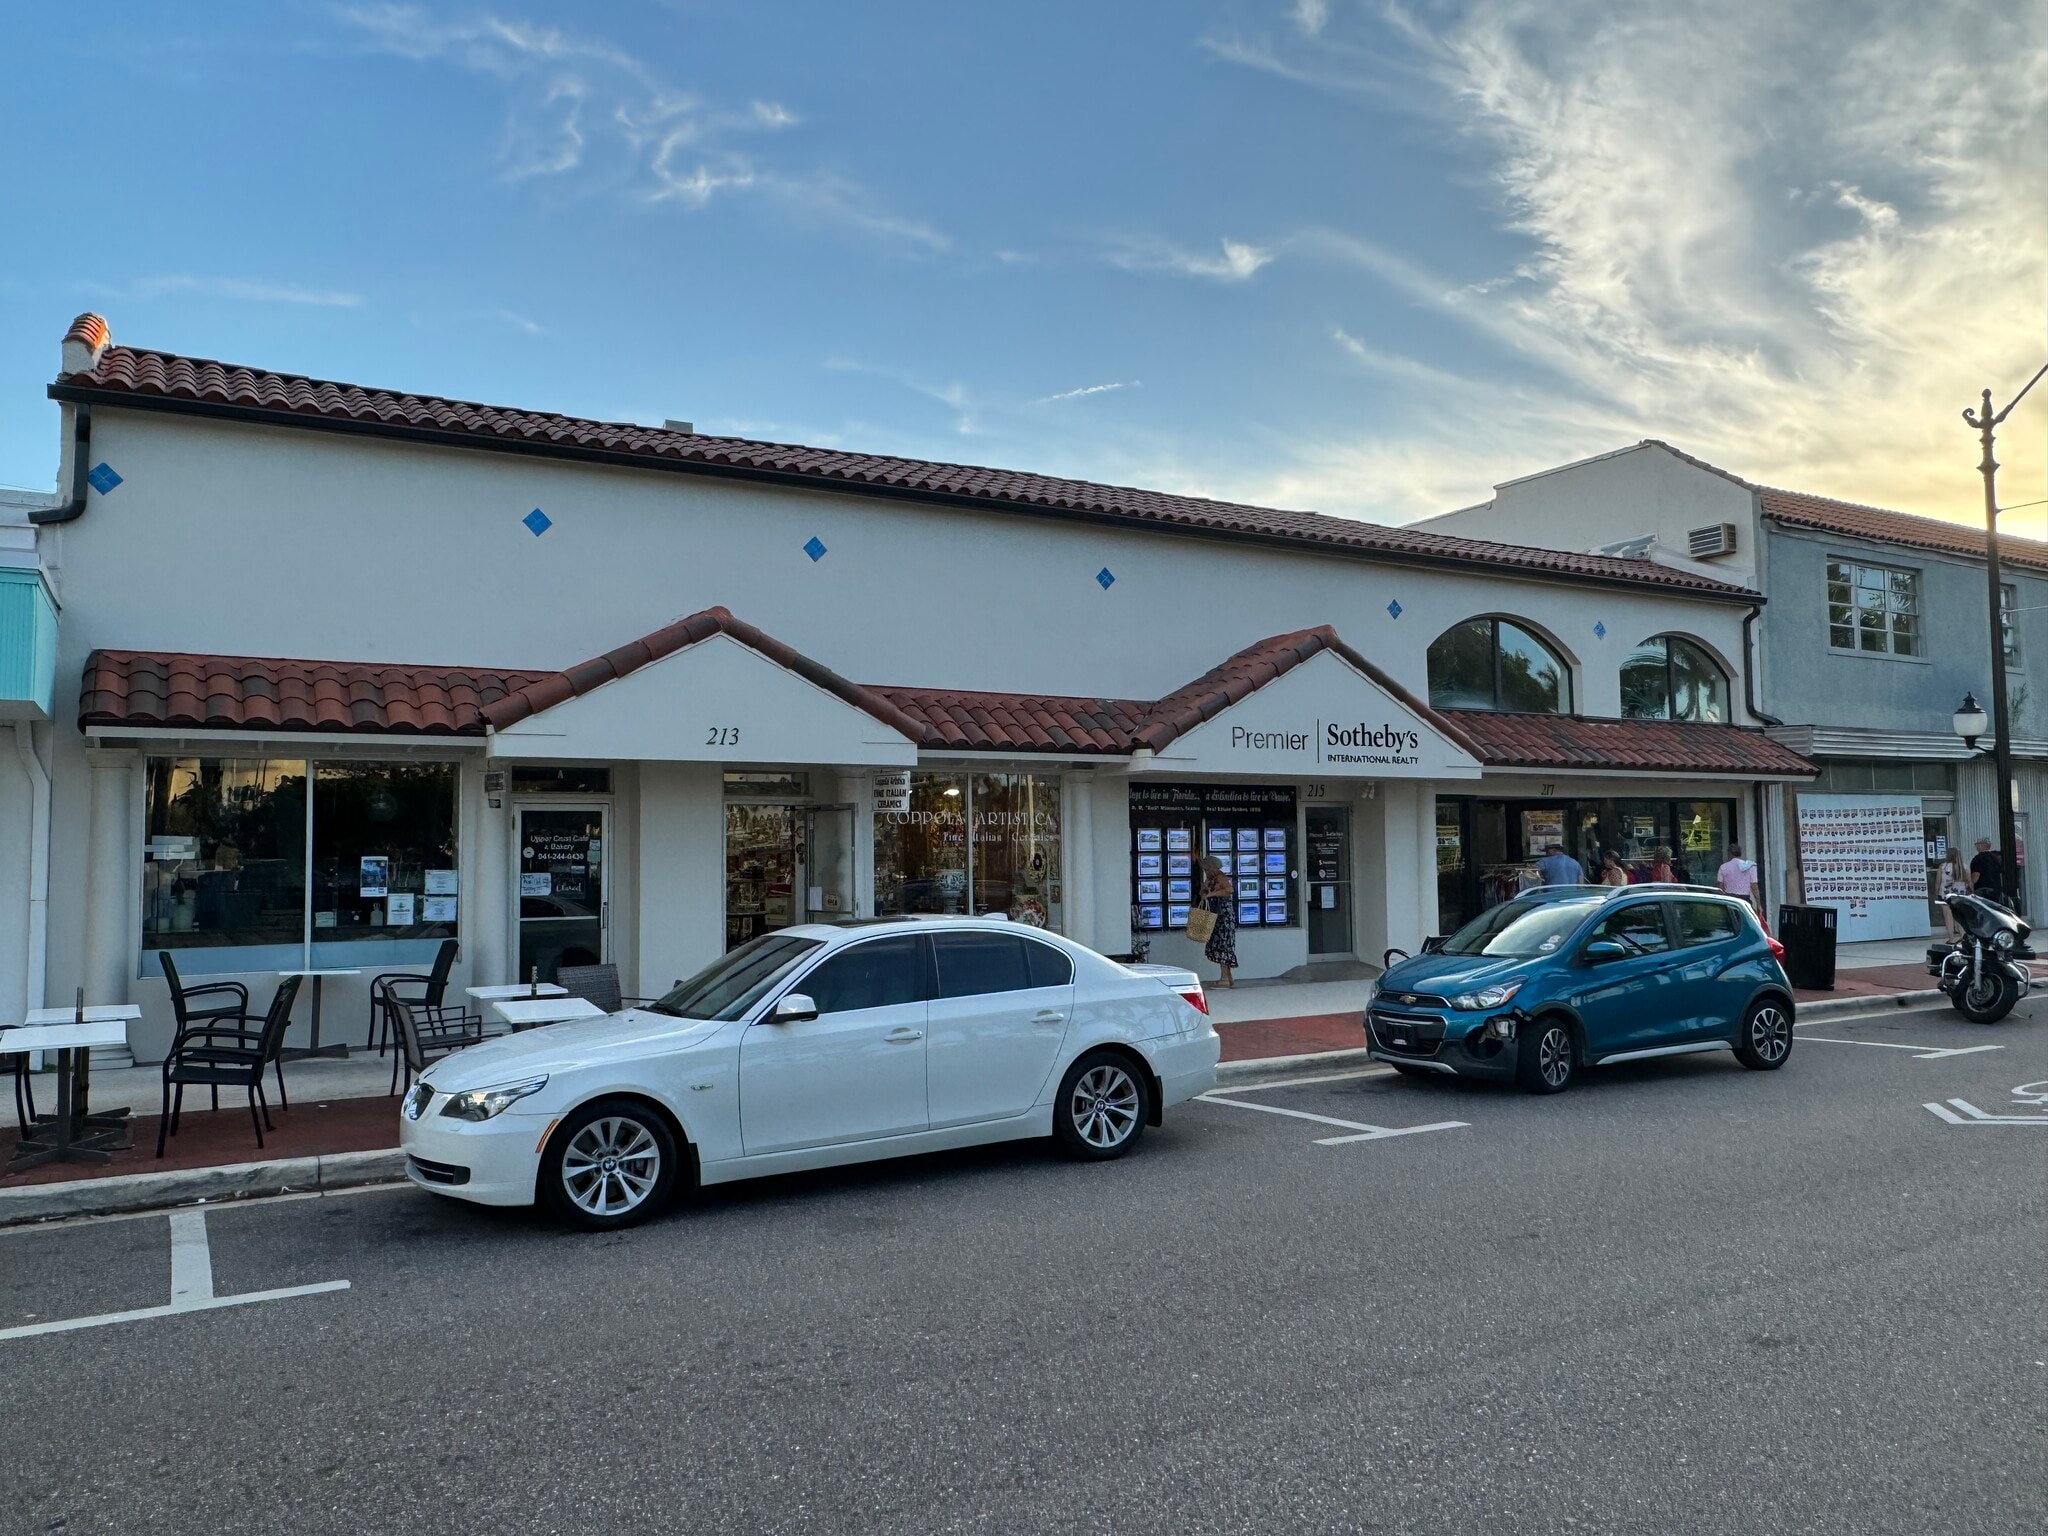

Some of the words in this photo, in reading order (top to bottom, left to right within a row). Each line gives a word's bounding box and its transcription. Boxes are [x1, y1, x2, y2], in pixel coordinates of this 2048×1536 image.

[705, 727, 740, 745] 213
[1232, 726, 1309, 750] Premier
[1327, 723, 1418, 753] Sotheby's
[1327, 754, 1390, 764] INTERNATIONAL
[1392, 756, 1418, 765] REALTY
[886, 789, 906, 798] ITALIAN
[1307, 784, 1325, 797] 215
[1541, 784, 1555, 796] 217
[877, 800, 901, 808] CERAMICS
[886, 811, 965, 825] COPPOLA
[976, 811, 1053, 825] ARTISTCA
[943, 831, 964, 842] Fine
[972, 831, 1002, 842] Italian
